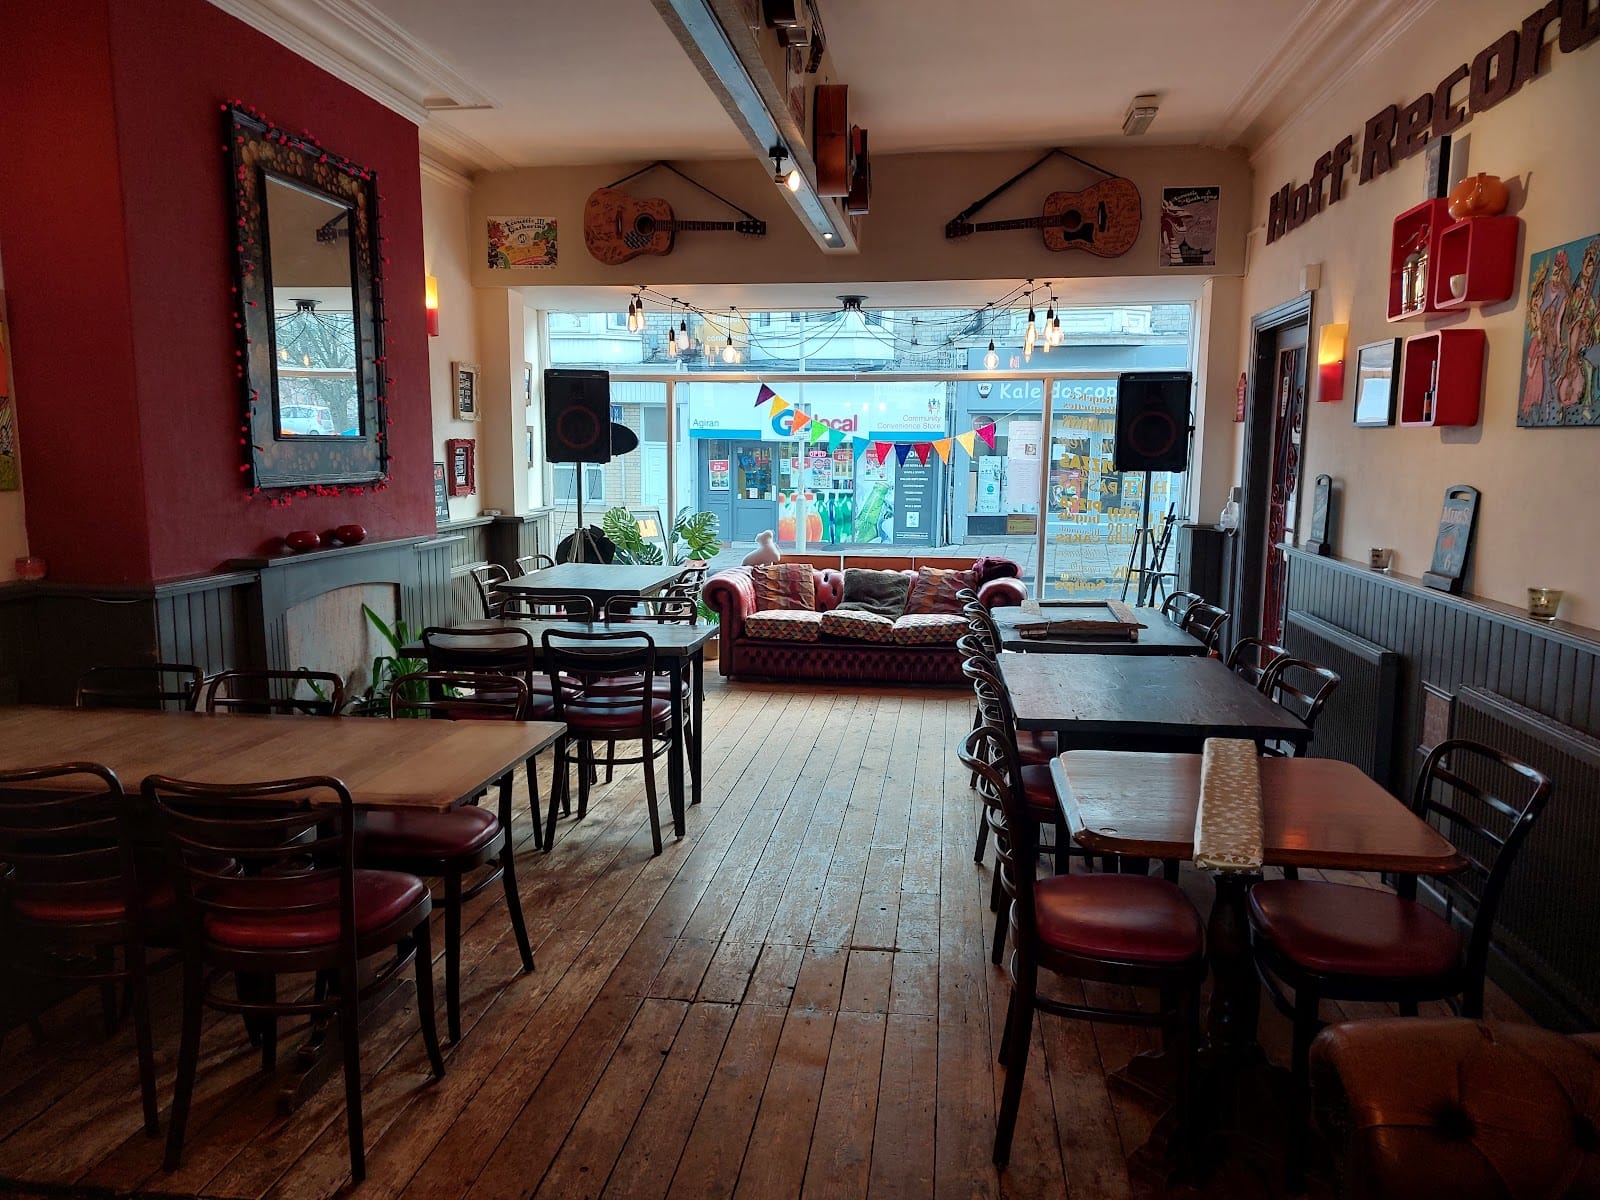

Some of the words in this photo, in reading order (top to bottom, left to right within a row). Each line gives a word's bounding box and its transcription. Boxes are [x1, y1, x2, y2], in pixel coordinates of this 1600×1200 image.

[692, 418, 720, 428] Agiran
[903, 414, 942, 423] Community
[877, 422, 920, 430] Convenience
[923, 422, 941, 430] Store
